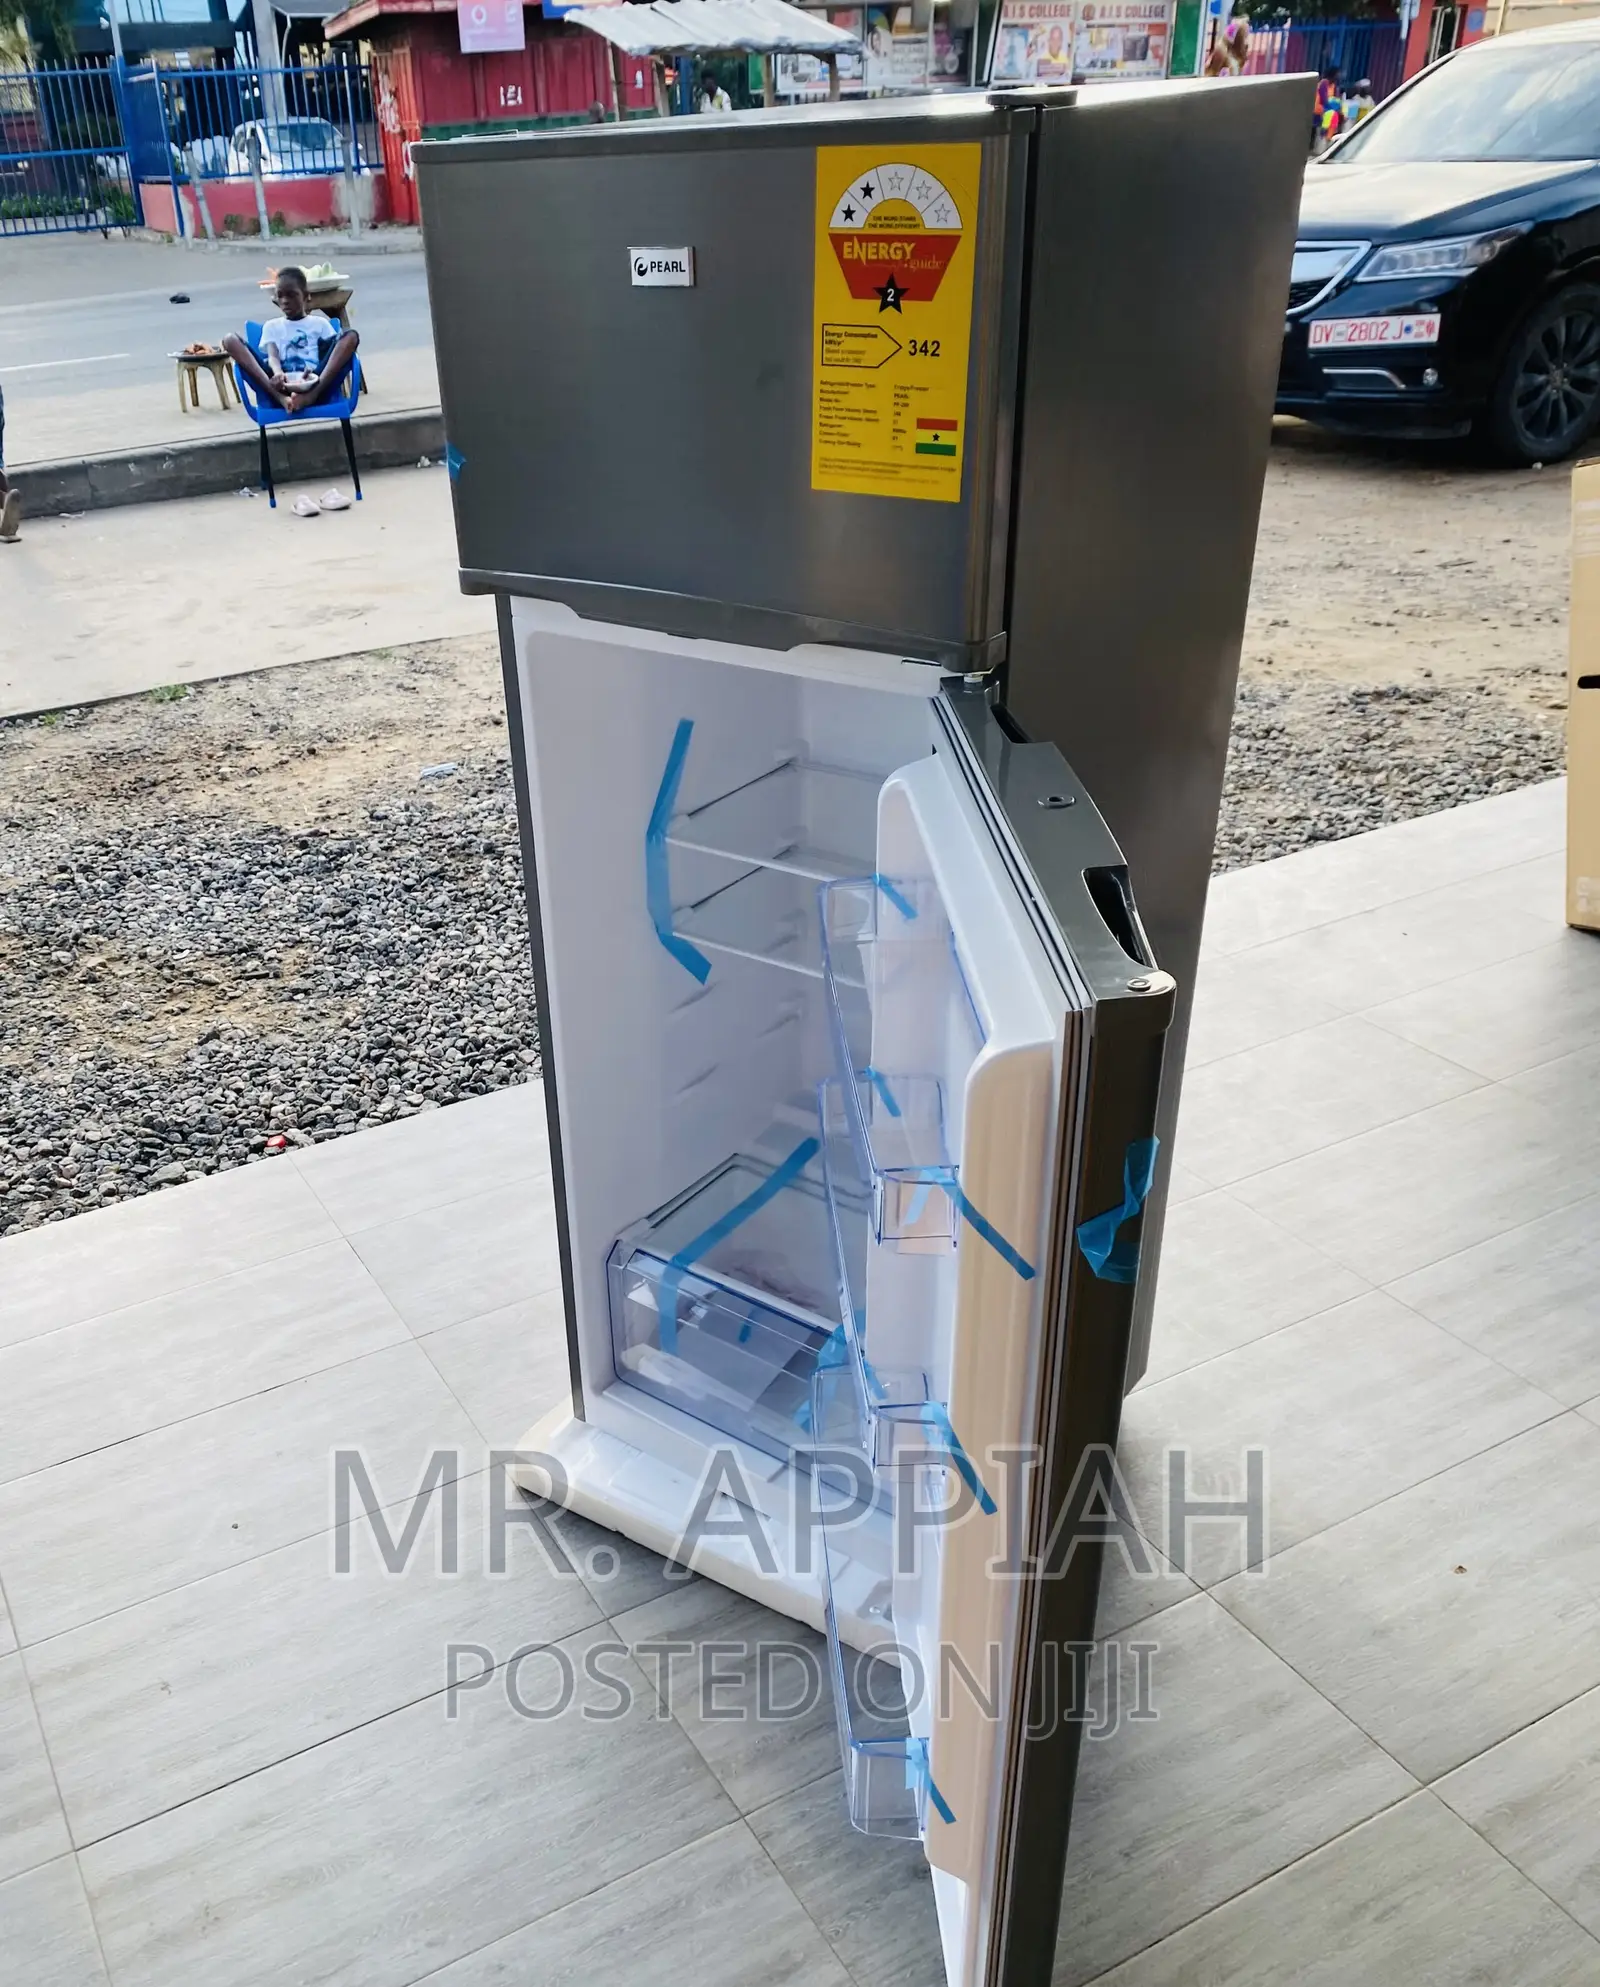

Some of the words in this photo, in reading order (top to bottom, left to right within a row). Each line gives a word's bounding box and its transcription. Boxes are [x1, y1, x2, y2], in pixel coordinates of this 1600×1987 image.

[1028, 4, 1072, 18] COLLEGE
[1125, 4, 1166, 18] COLLEGE
[843, 236, 916, 265] ENERGY
[650, 260, 686, 273] PEARL
[886, 288, 895, 302] 2
[908, 339, 941, 357] 342
